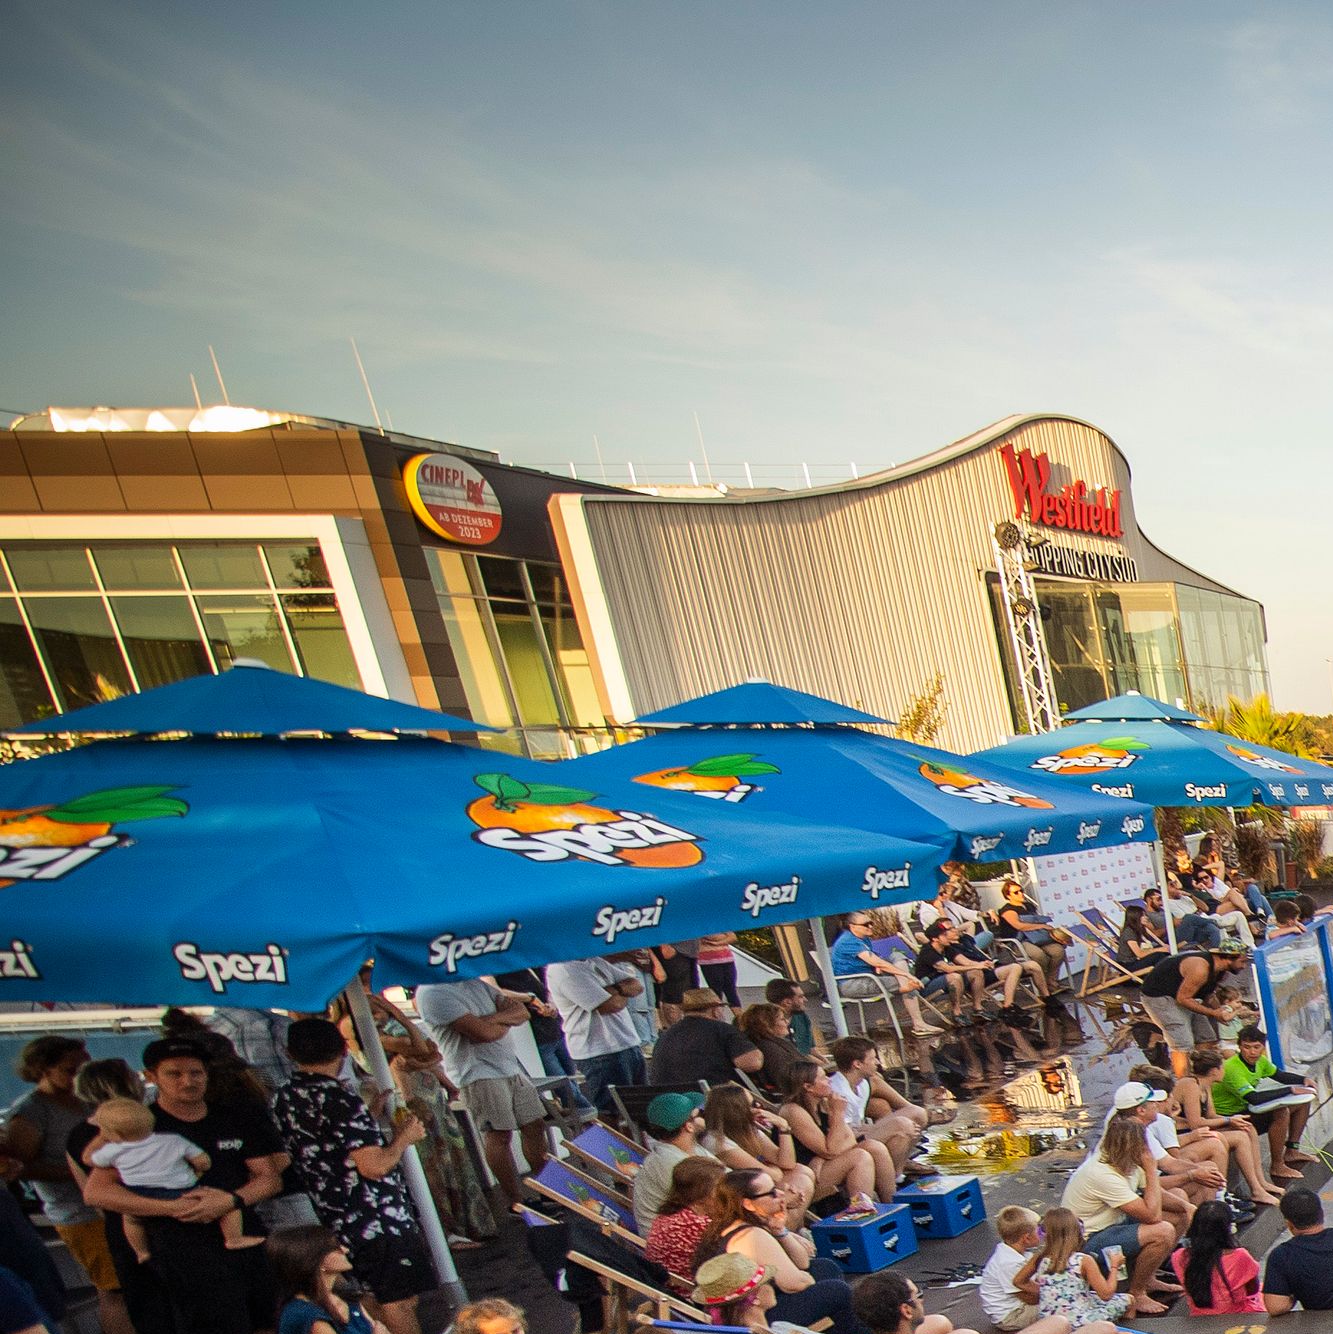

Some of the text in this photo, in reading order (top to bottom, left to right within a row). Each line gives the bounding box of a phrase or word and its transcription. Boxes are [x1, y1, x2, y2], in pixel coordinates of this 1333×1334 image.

[1000, 443, 1124, 538] Westfield
[439, 512, 493, 528] AB DEZEMBER
[459, 526, 481, 539] 2023
[1025, 545, 1084, 578] HOPPING
[1028, 753, 1136, 772] Spezi
[1184, 783, 1227, 802] Spezi
[478, 810, 698, 866] Spezi
[741, 875, 800, 918] Spezi
[861, 861, 911, 899] Spezi
[592, 897, 665, 942] Spezi
[429, 921, 516, 972] Spezi
[173, 943, 287, 993] Spezi
